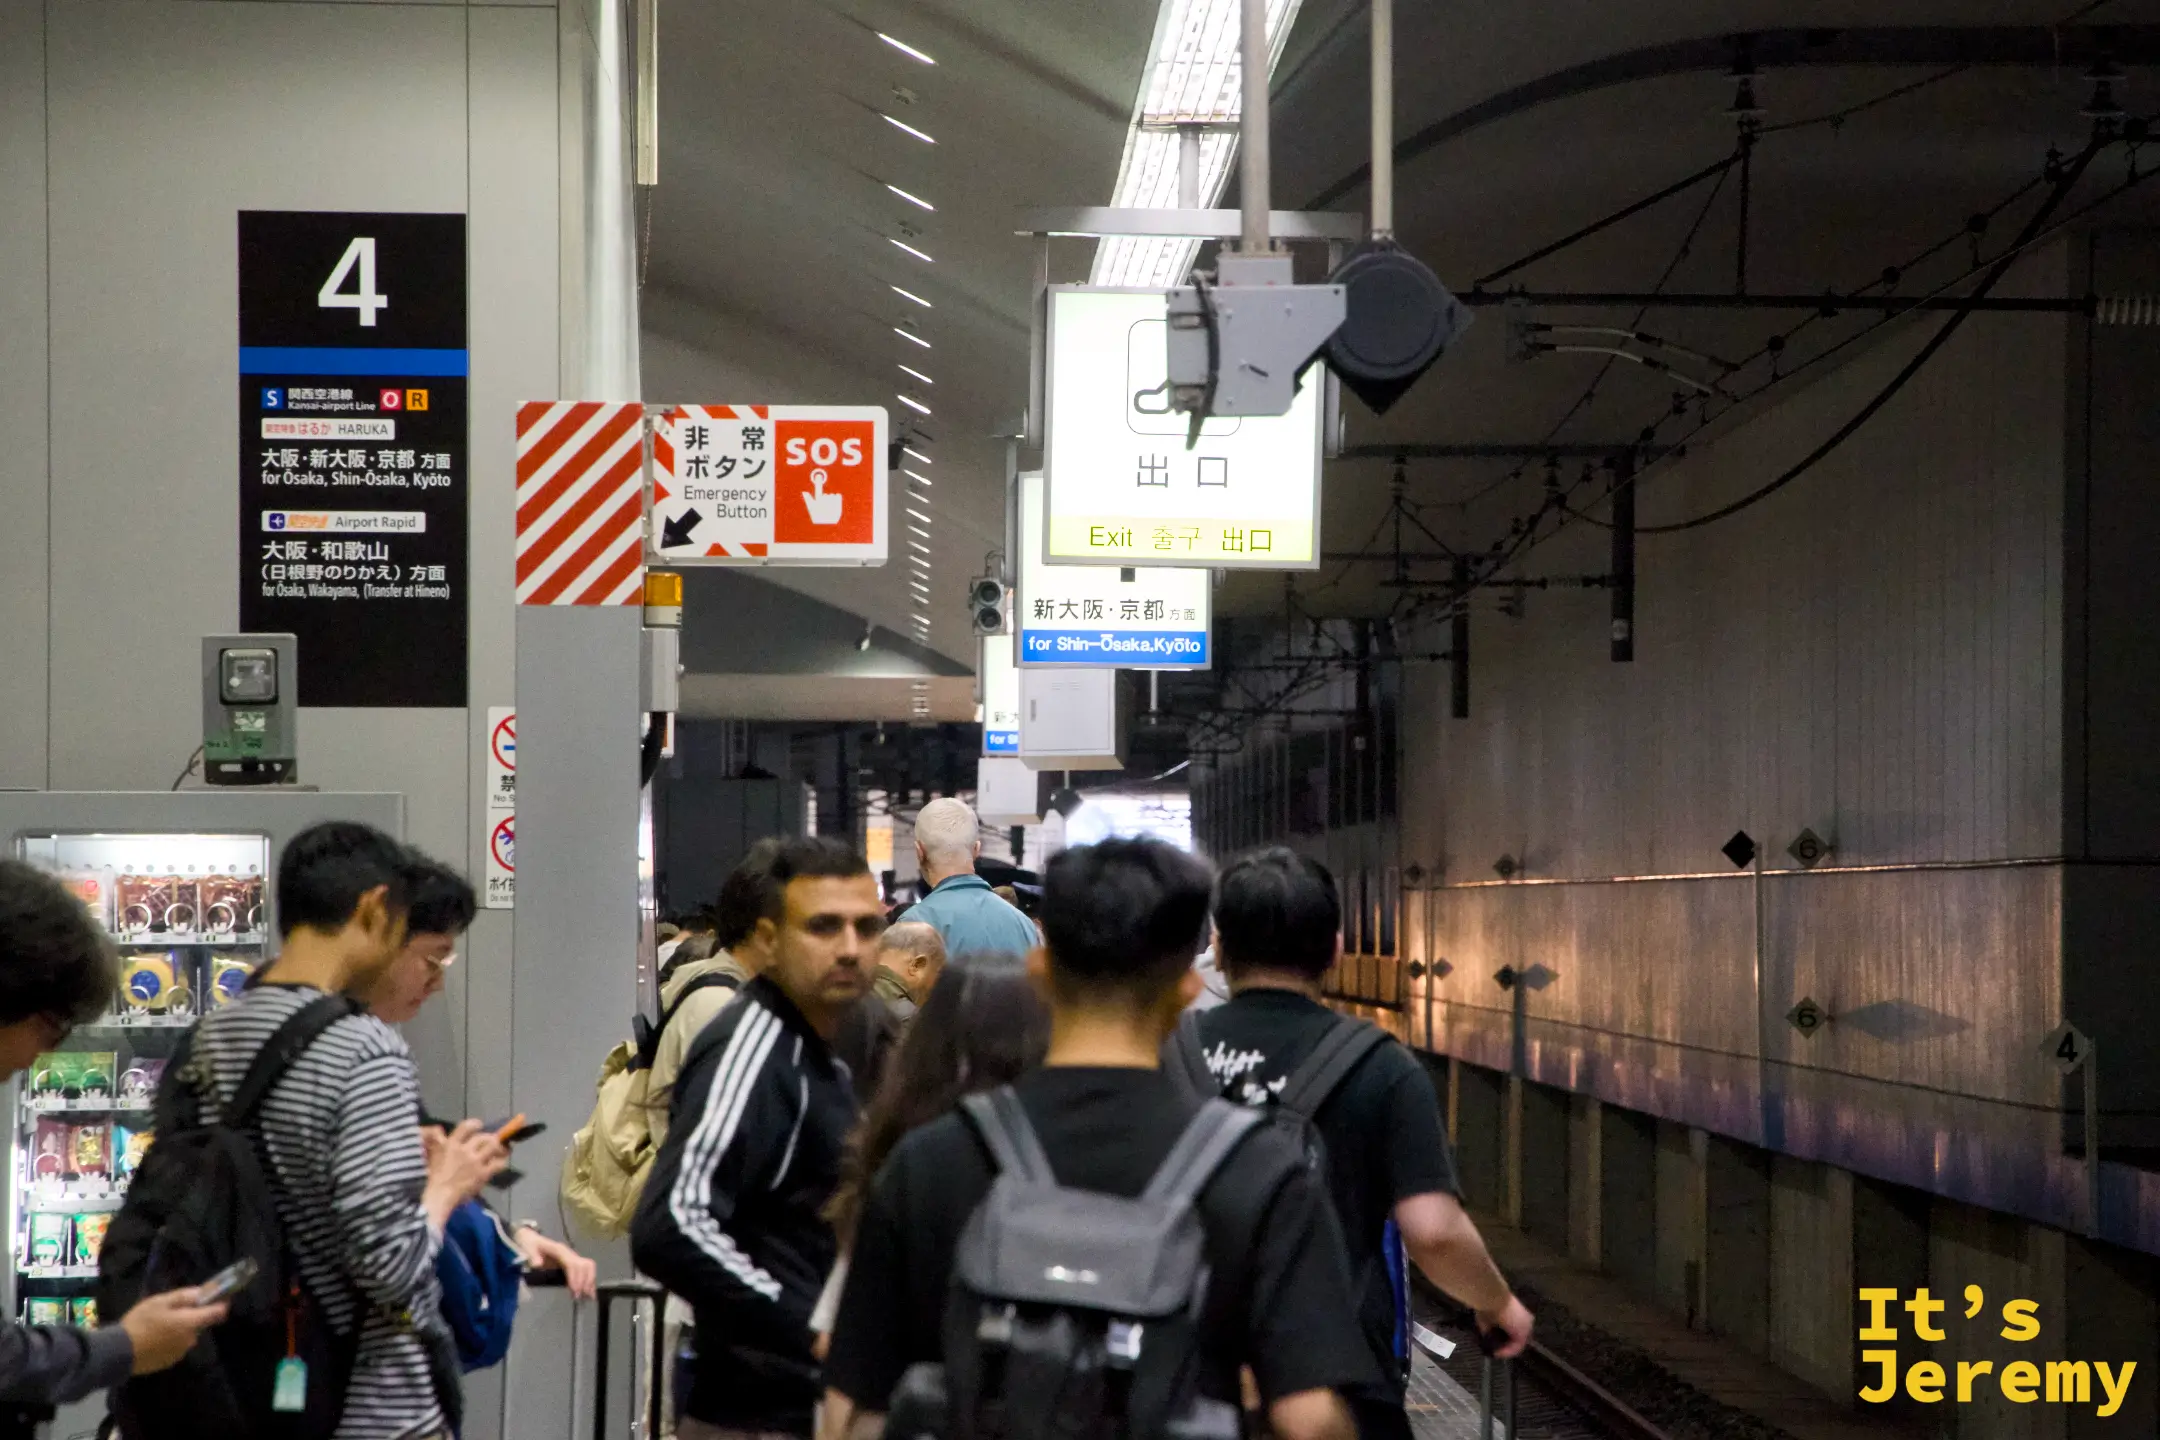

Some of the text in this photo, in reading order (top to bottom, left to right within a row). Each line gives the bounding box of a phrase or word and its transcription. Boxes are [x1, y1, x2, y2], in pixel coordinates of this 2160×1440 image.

[318, 237, 388, 326] 4
[267, 390, 278, 406] S
[287, 401, 376, 411] Kansai-airport Line
[383, 391, 399, 408] O
[411, 392, 424, 407] R
[299, 423, 332, 435] はるか
[338, 424, 388, 435] HARUKA
[684, 425, 766, 451] 非常
[785, 437, 863, 466] SOS
[420, 453, 451, 469] 方面
[685, 455, 767, 479] ボタン
[1137, 453, 1228, 488] 出口
[262, 469, 451, 490] for Ōsaka, Shin-Ōsaka, Kyōto
[684, 485, 767, 502] Emergency
[717, 504, 767, 519] Button
[335, 516, 378, 530] Airport
[381, 516, 416, 530] Rapid
[1089, 525, 1272, 552] Exit 출구 出口
[262, 541, 389, 561] 大阪・和歌山
[409, 565, 446, 581] 方面
[262, 583, 275, 597] for
[308, 583, 359, 600] Wakayama,
[363, 583, 402, 599] (Transfer
[404, 585, 413, 597] at
[415, 583, 450, 599] Hineno)
[1033, 598, 1196, 621] 新大阪・京都 方面
[1028, 636, 1052, 651] for
[989, 733, 1006, 745] for
[1799, 838, 1818, 859] 6
[1797, 1008, 1817, 1028] 6
[2056, 1030, 2078, 1063] 4
